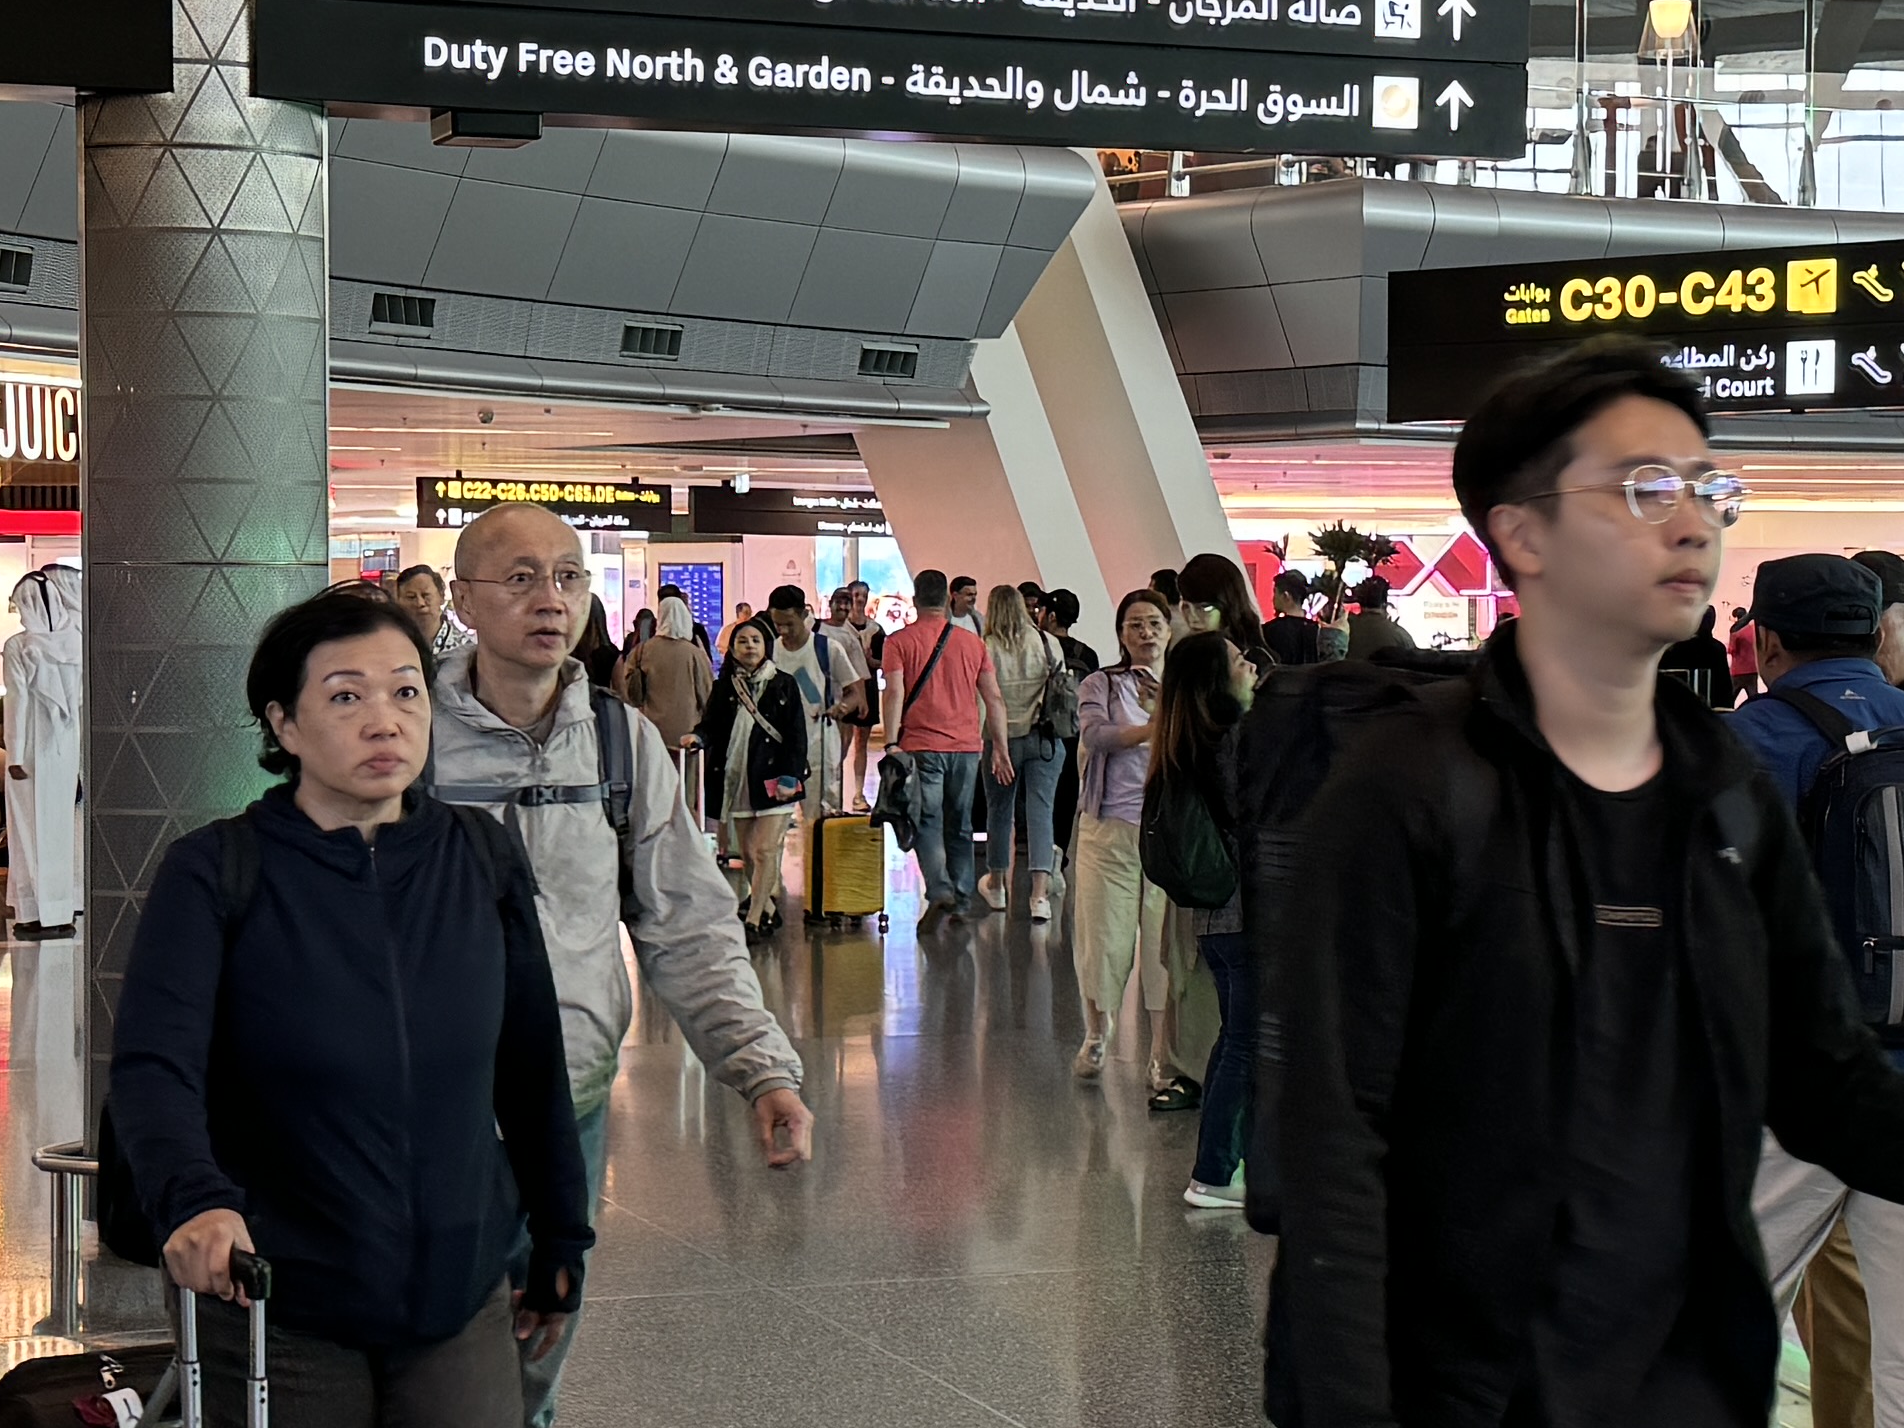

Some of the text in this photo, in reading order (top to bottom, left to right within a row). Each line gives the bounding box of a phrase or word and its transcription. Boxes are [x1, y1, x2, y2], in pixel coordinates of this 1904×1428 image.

[425, 37, 508, 80] Duty
[519, 43, 595, 76] Free
[607, 48, 704, 82] North
[714, 54, 738, 84] &
[748, 56, 871, 92] Garden
[906, 64, 1044, 106] والحديقة
[1054, 70, 1146, 111] شمال
[1179, 78, 1247, 116] الحرة
[1257, 84, 1359, 124] السوق
[1504, 283, 1550, 303] بوابات
[1560, 268, 1775, 321] C30-C43
[1506, 307, 1550, 324] Gates
[1740, 344, 1775, 371] ركن
[1716, 377, 1774, 397] Court
